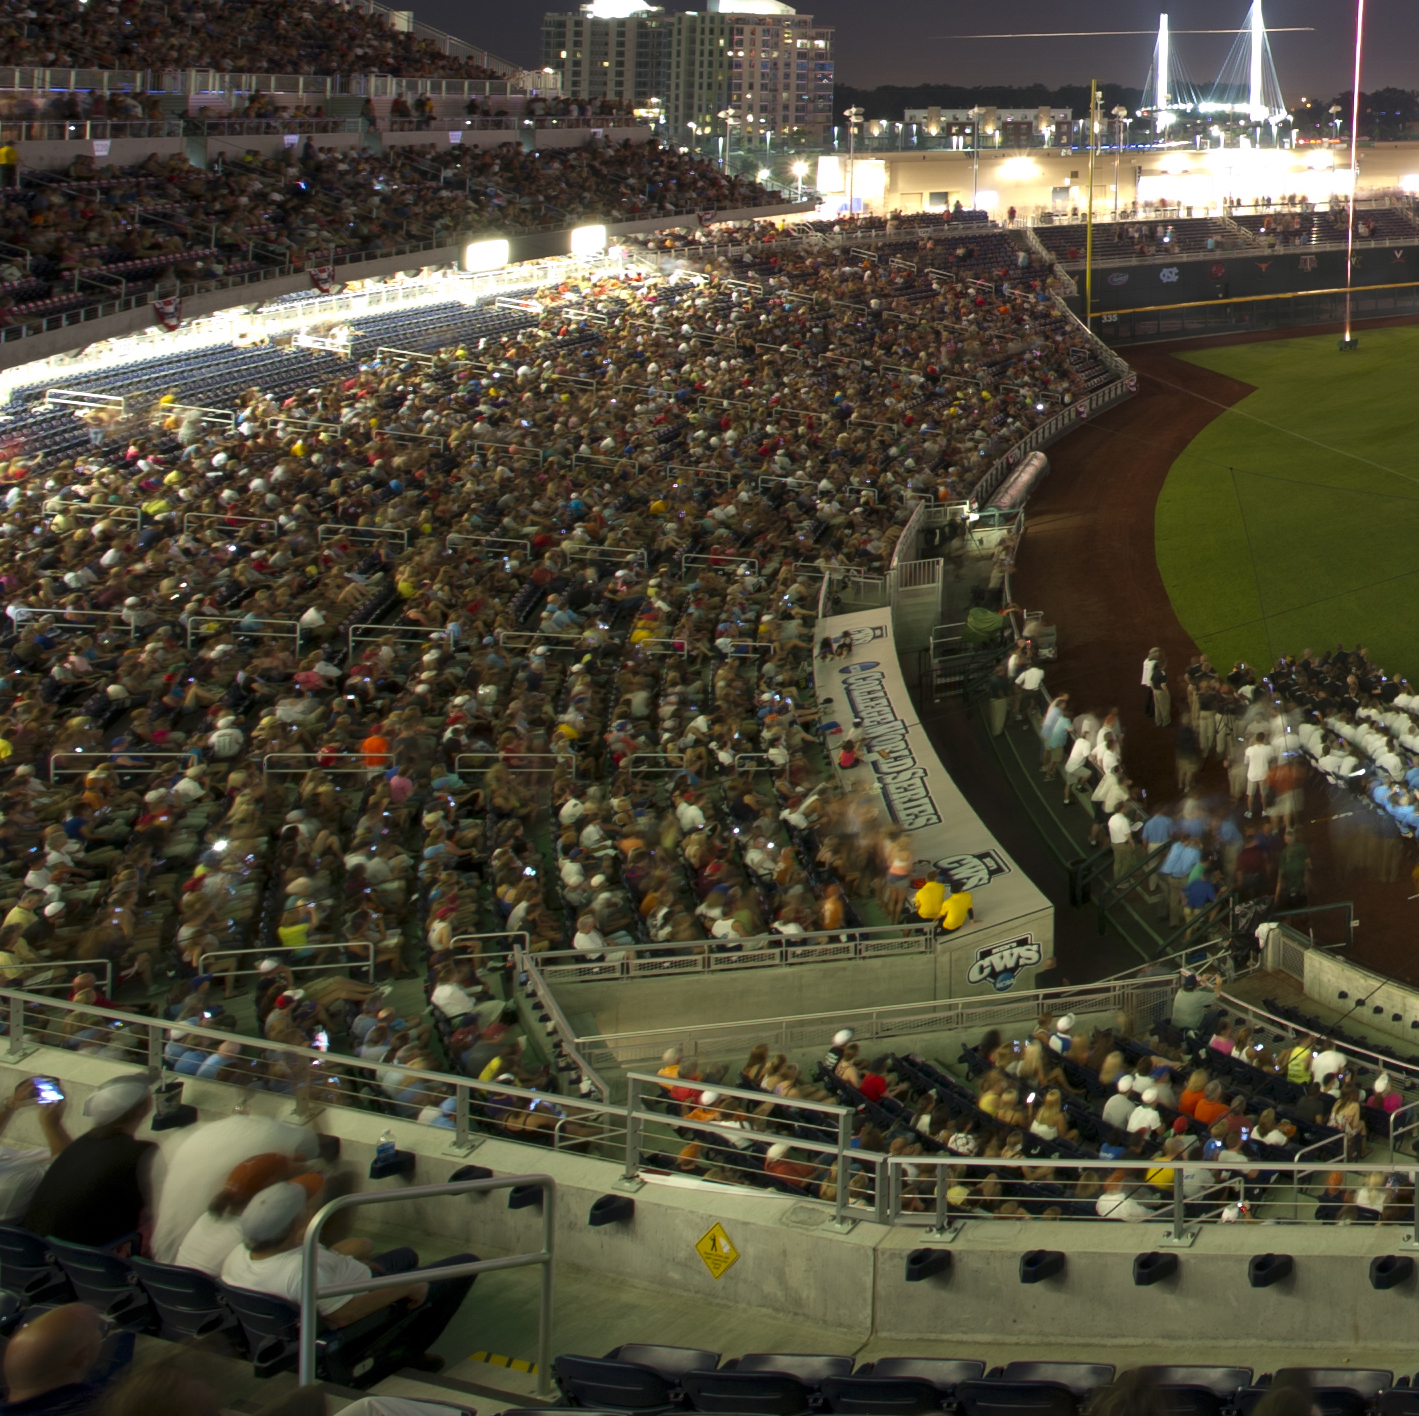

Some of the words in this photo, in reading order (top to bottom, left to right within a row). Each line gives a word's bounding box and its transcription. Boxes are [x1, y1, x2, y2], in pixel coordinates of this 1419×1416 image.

[1102, 314, 1118, 322] 335
[877, 767, 943, 832] SERIES
[935, 854, 990, 891] CWS
[968, 944, 1040, 983] CWS
